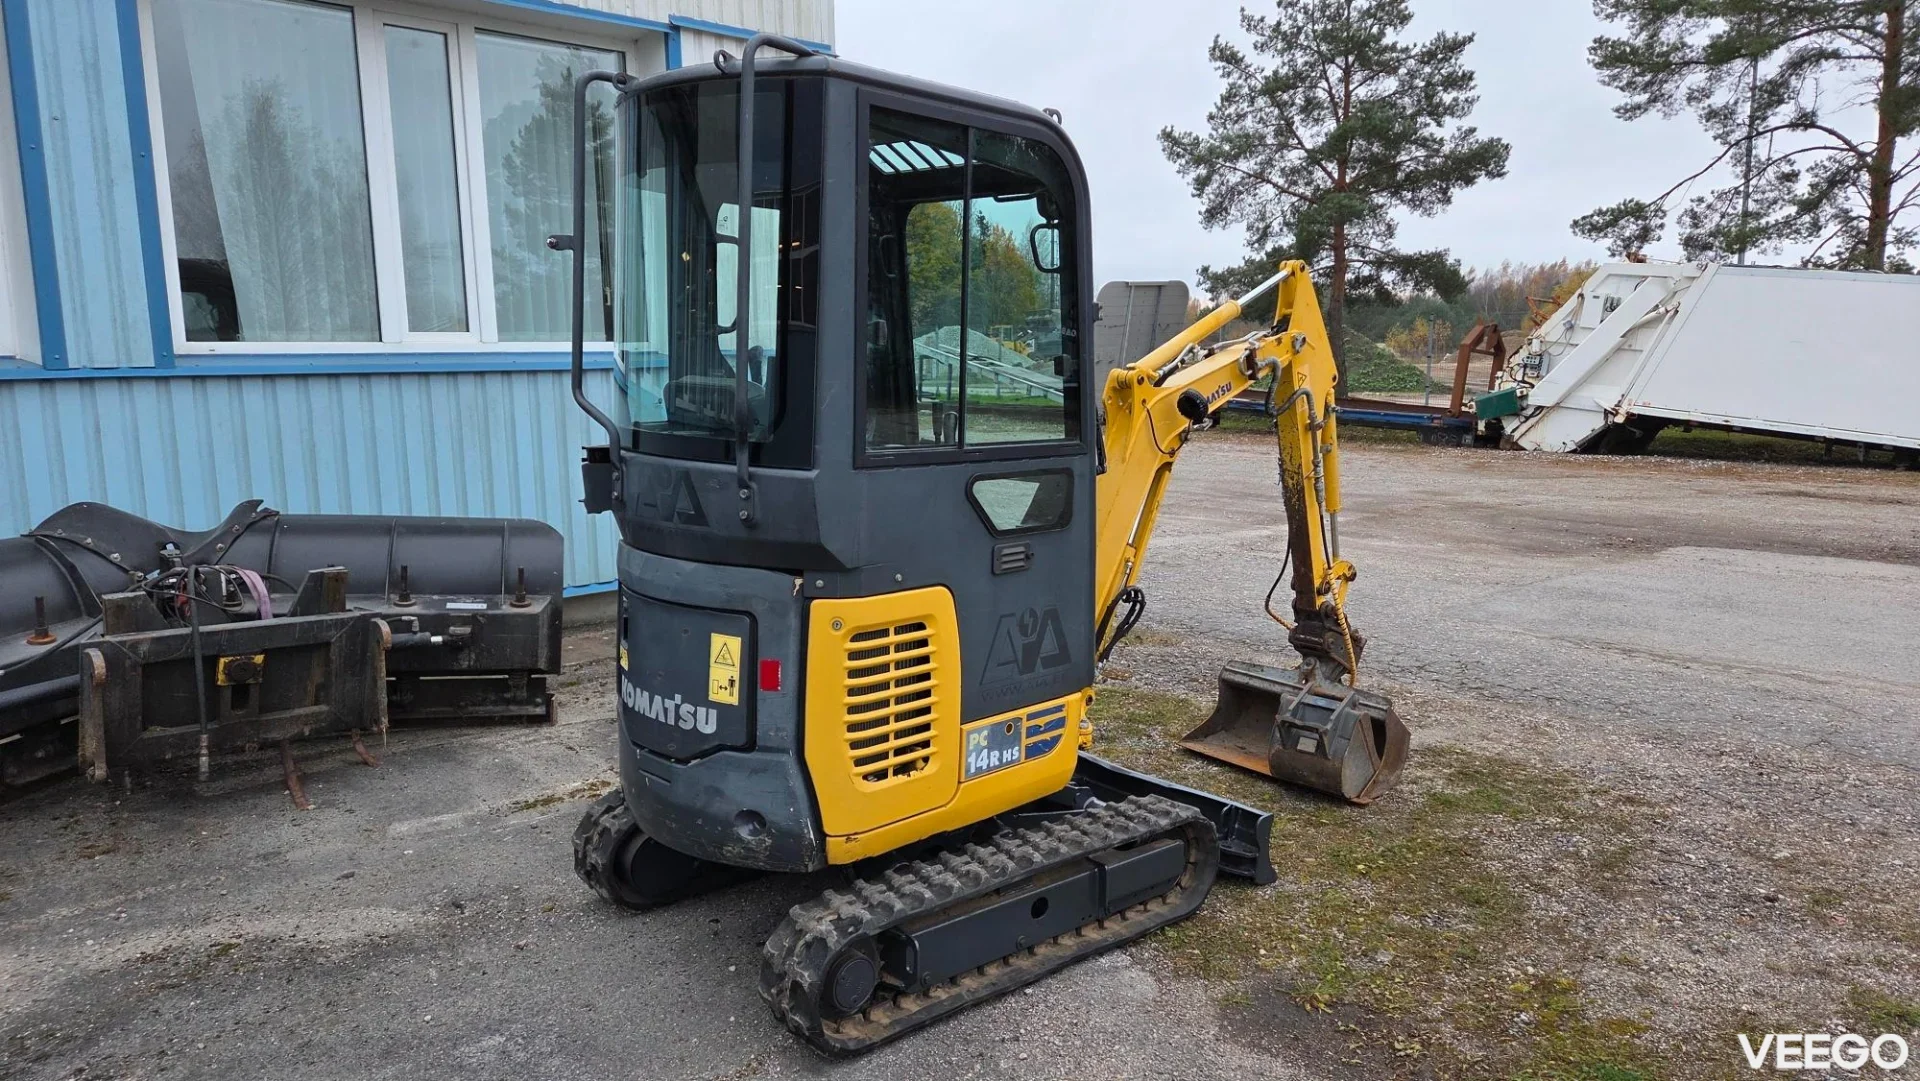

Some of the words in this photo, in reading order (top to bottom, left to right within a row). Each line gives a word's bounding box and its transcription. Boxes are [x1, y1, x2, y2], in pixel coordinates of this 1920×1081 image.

[621, 674, 717, 734] KOMATSU
[968, 729, 989, 750] PC
[1002, 746, 1020, 764] HS
